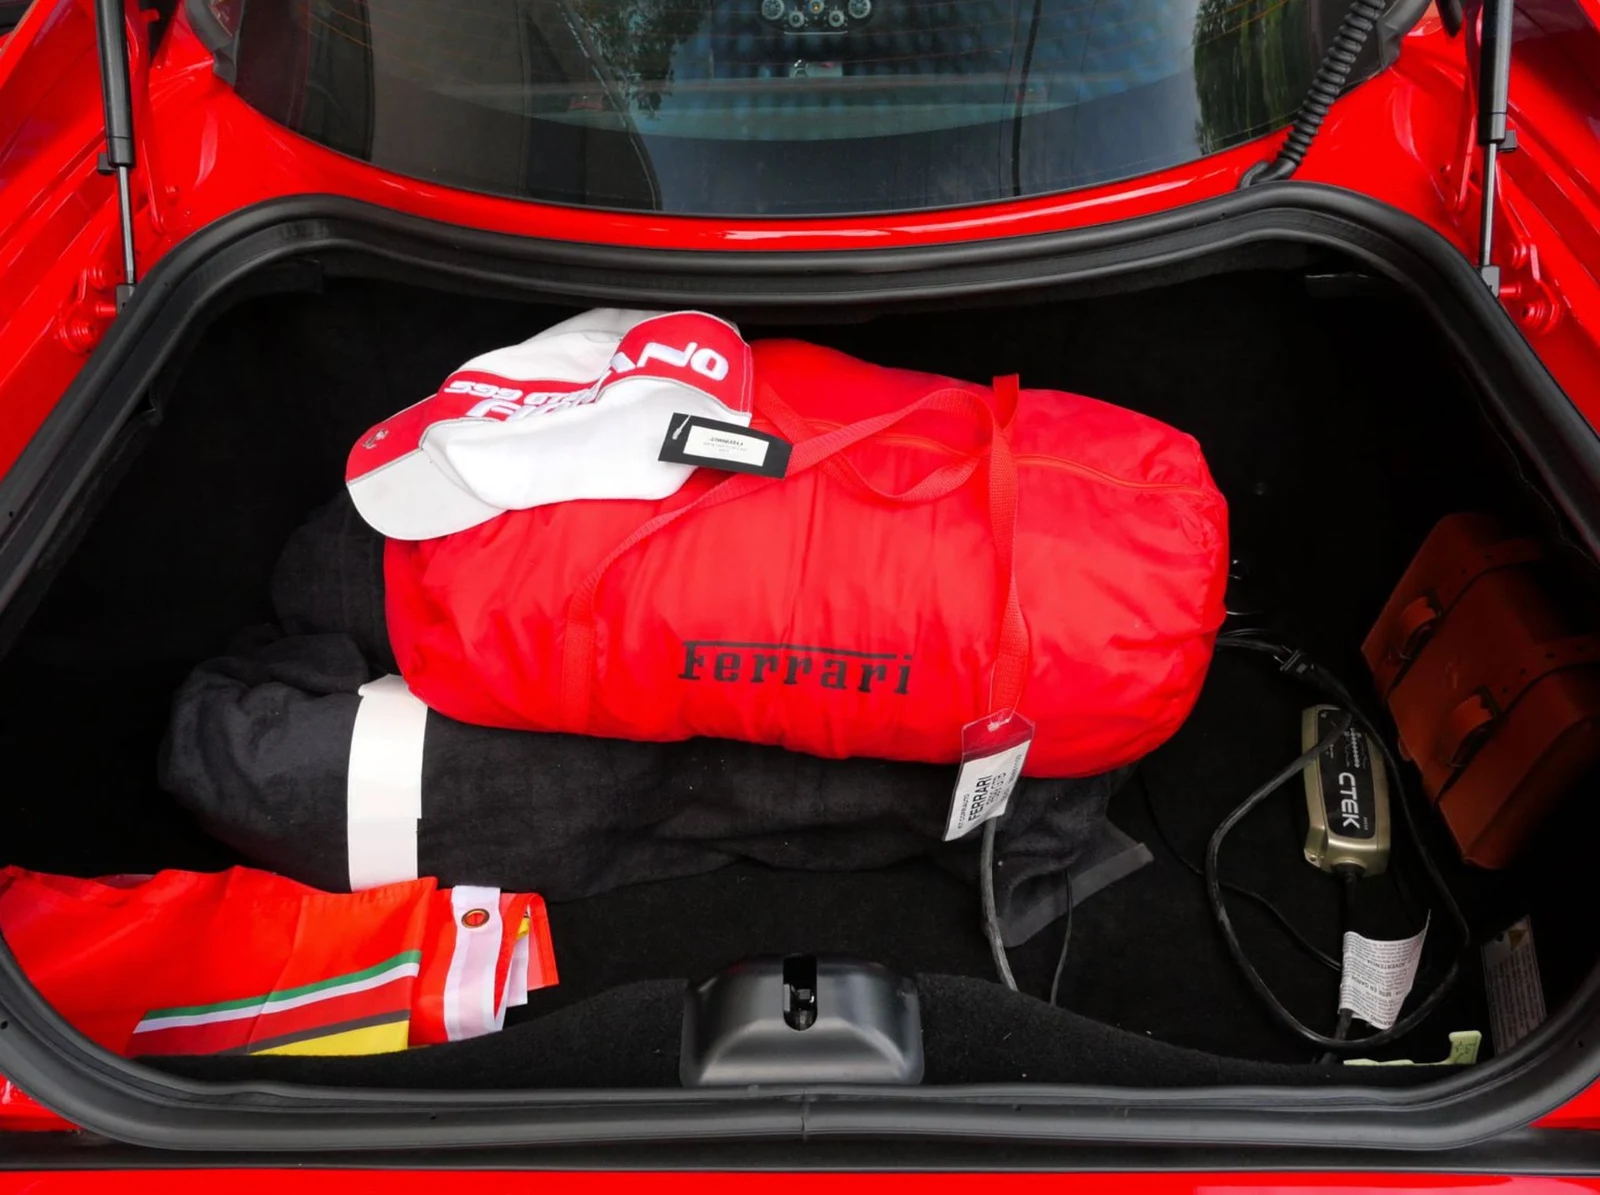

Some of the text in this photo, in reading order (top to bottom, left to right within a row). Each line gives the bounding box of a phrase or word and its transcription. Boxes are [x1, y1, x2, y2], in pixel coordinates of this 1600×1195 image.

[444, 379, 524, 401] 599
[678, 640, 913, 695] Ferrari
[968, 775, 993, 822] FERRARI
[1338, 772, 1360, 829] CTEK
